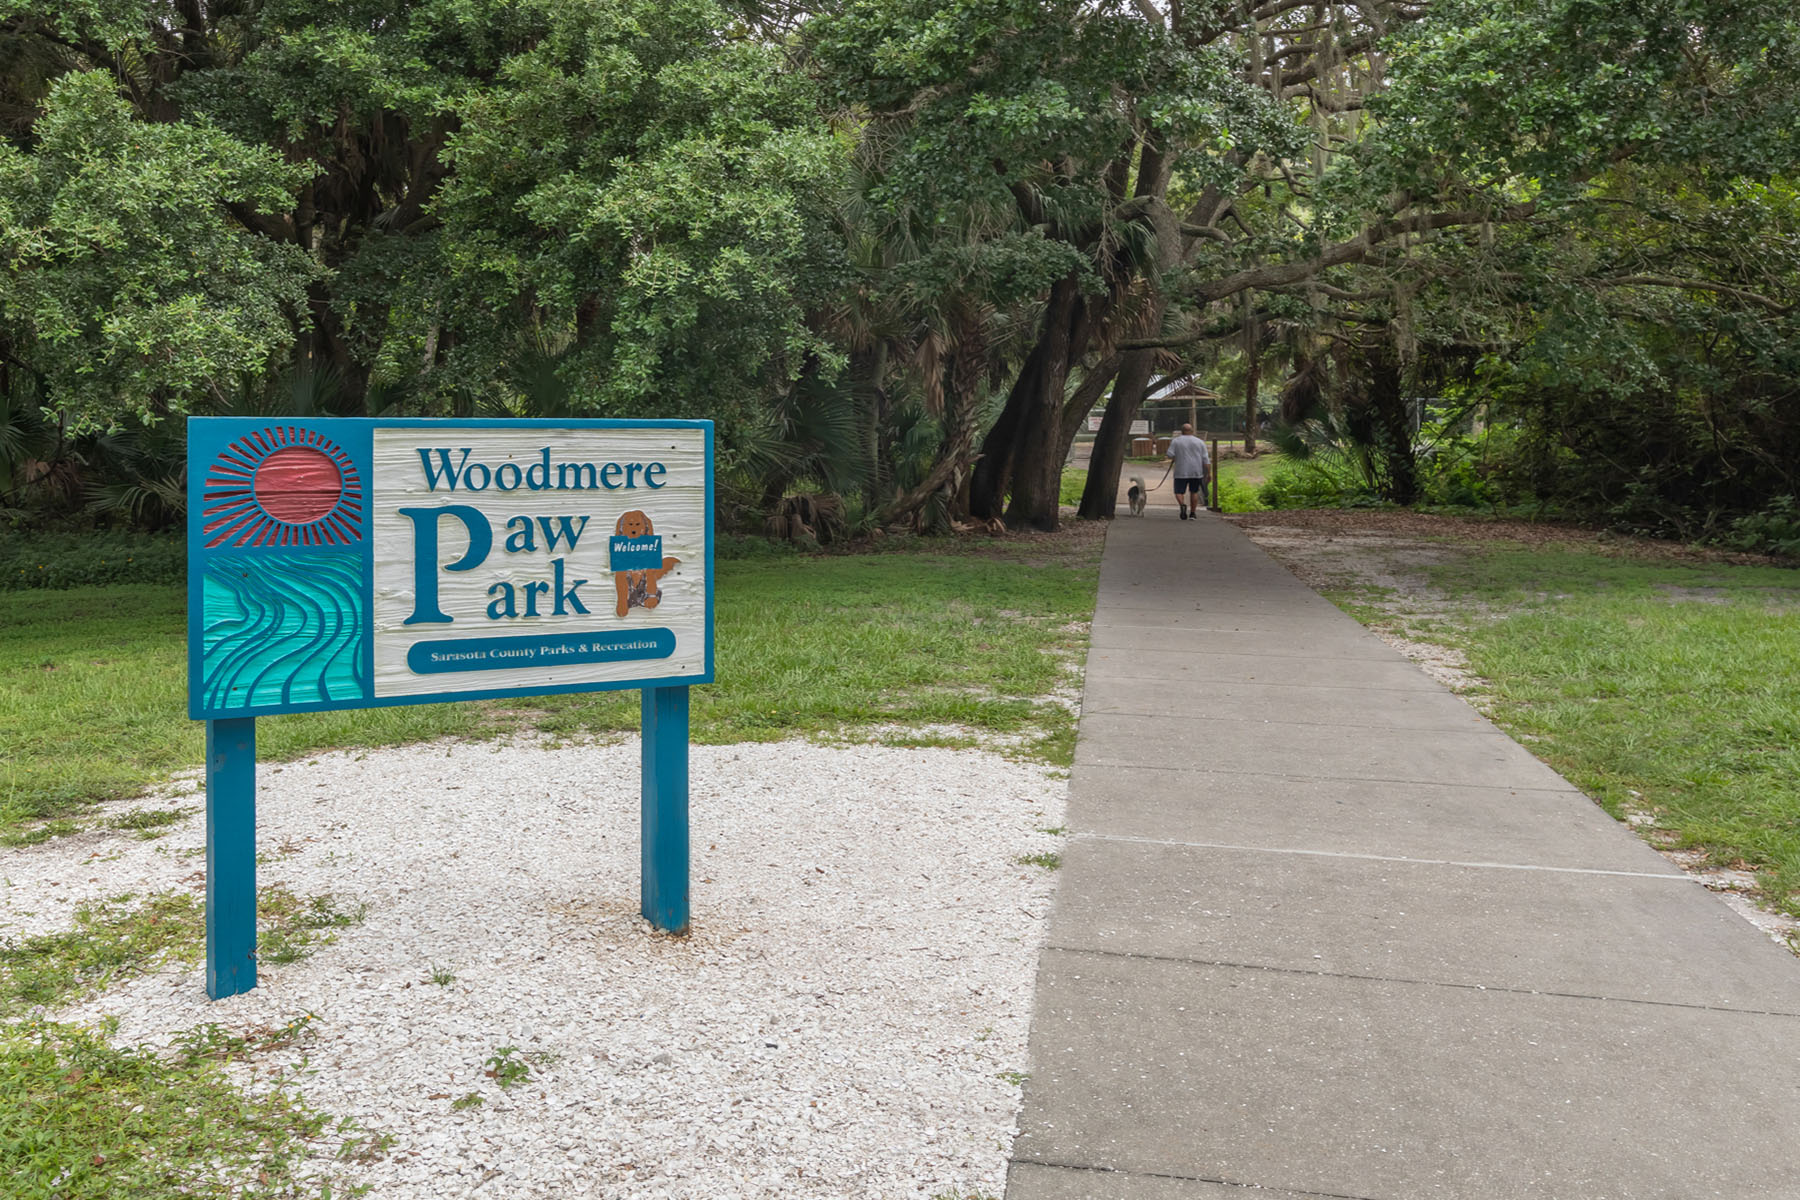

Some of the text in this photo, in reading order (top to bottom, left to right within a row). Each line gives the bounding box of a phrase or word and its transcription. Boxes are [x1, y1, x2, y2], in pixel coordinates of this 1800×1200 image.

[416, 446, 667, 491] Woodmere
[613, 538, 659, 552] Welcome!
[430, 639, 657, 662] Sarasota County Parks & Recreation
